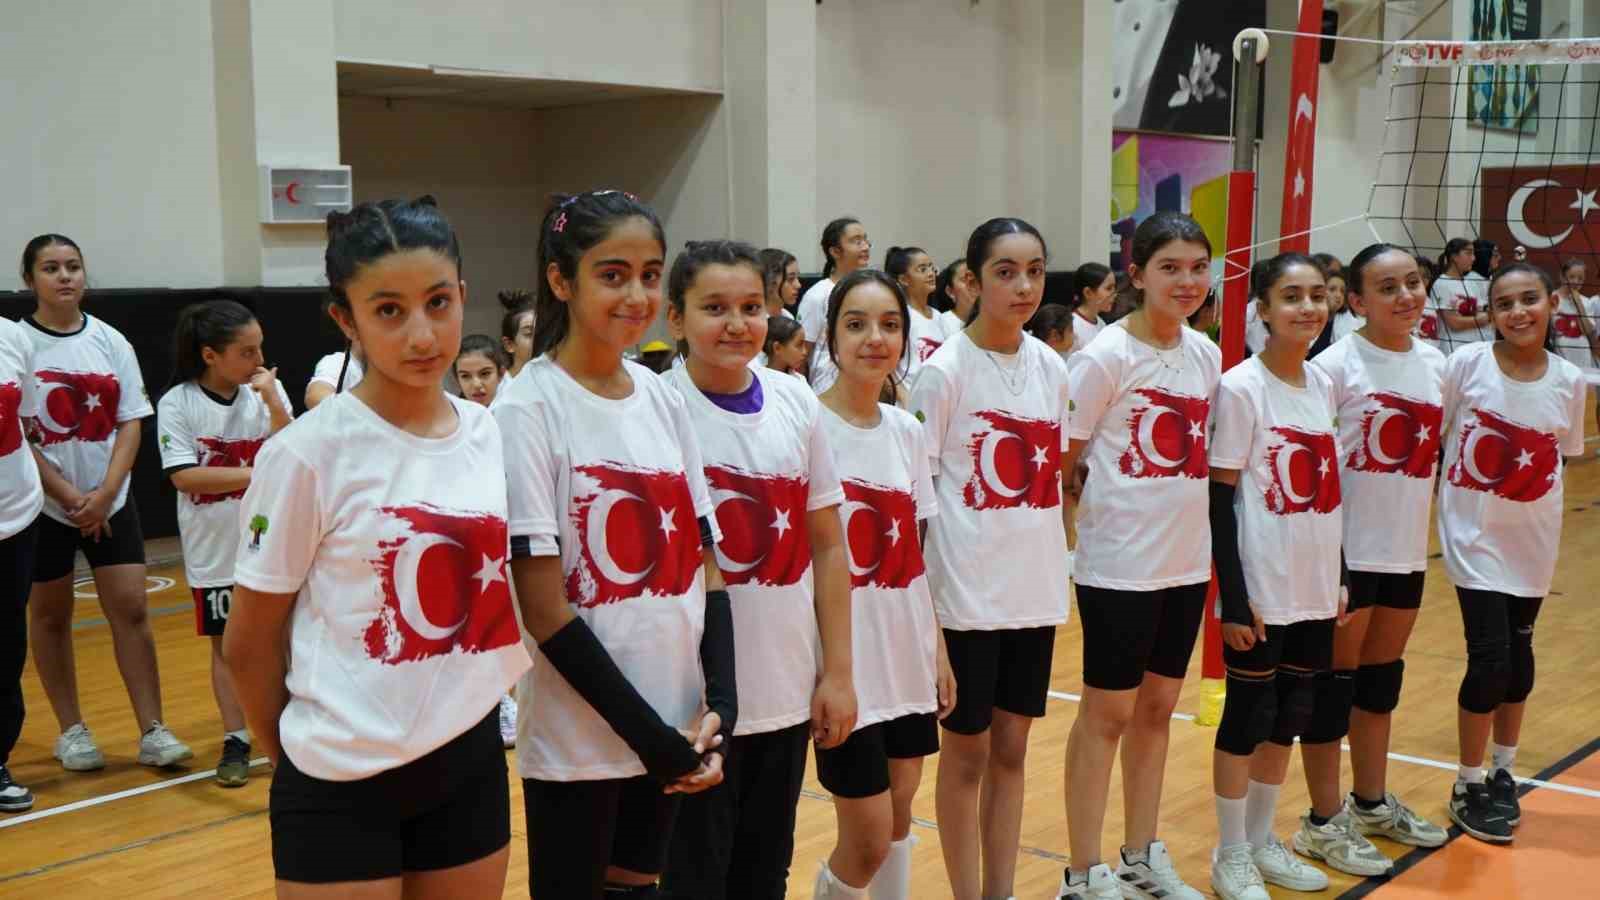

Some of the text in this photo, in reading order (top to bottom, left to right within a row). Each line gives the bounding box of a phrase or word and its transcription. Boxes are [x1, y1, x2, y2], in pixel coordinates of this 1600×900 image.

[1425, 43, 1463, 60] TVF
[1585, 47, 1600, 56] TV
[207, 589, 232, 620] 10
